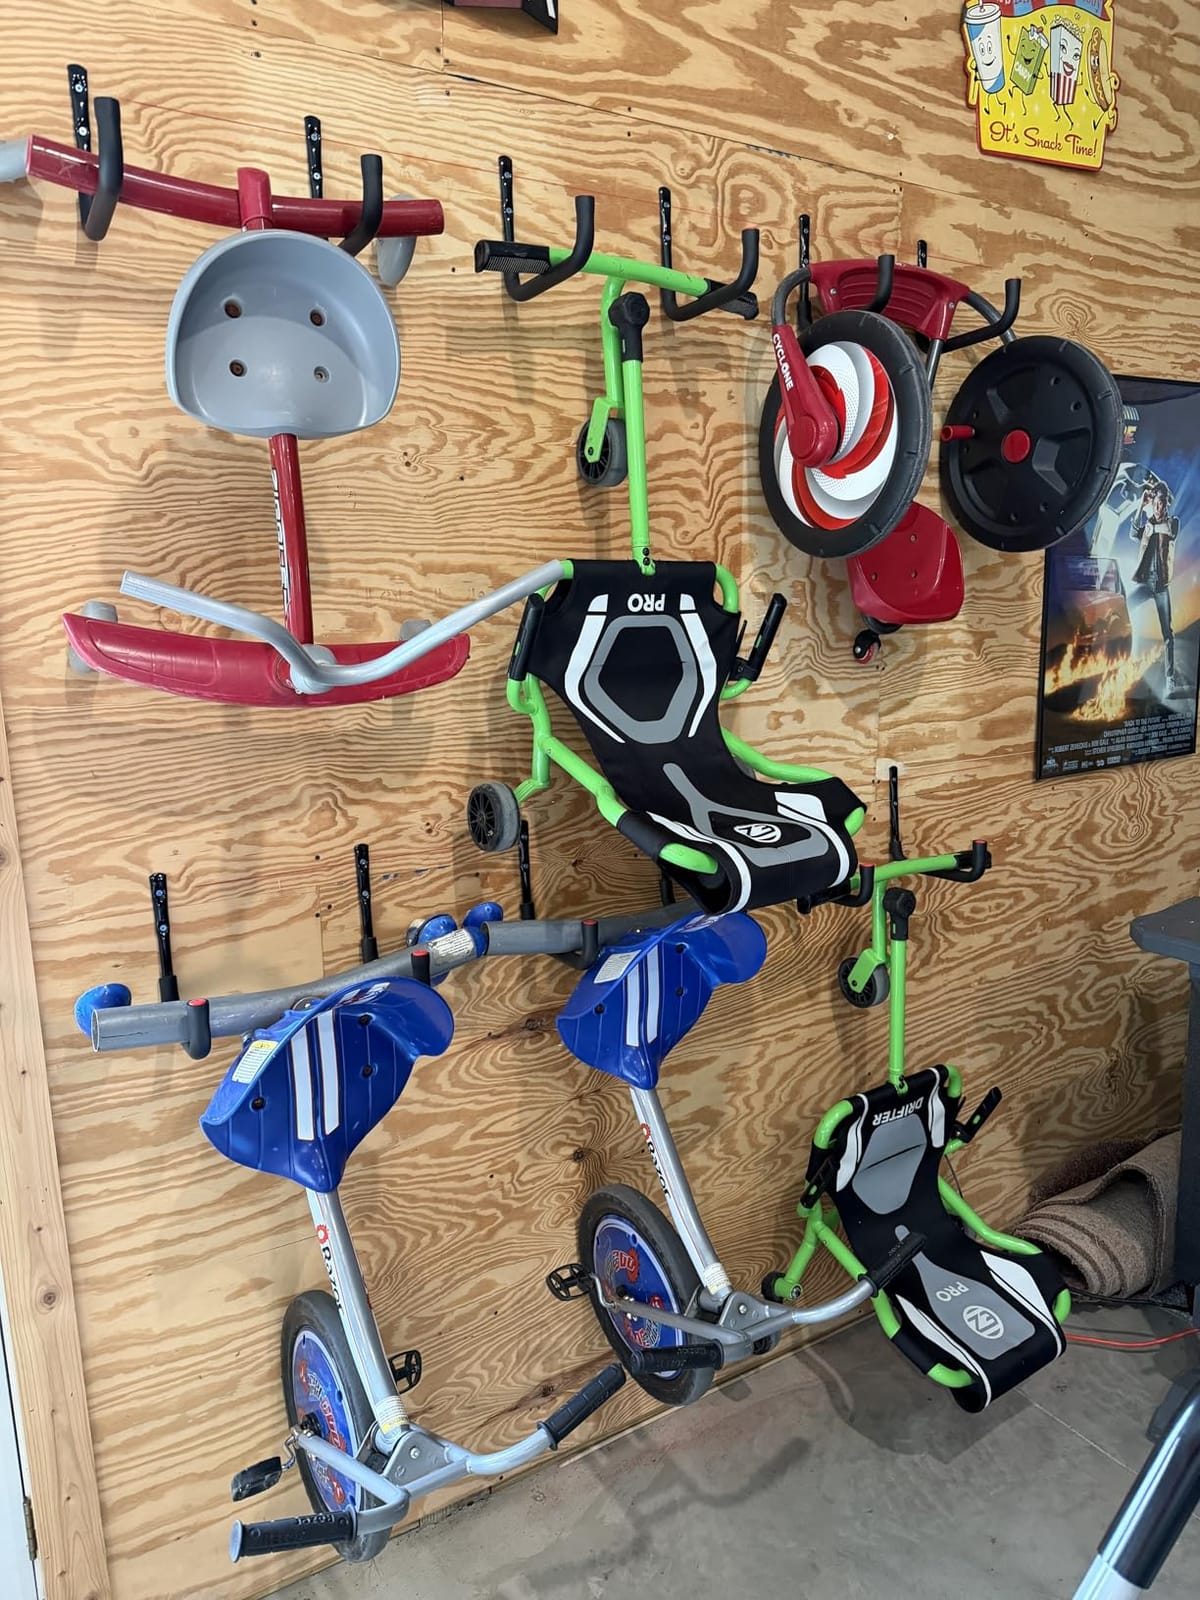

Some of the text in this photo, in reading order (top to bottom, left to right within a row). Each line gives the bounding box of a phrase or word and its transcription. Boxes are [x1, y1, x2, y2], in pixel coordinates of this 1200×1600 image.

[989, 120, 1098, 158] It's Snack Time!
[773, 333, 794, 391] CYCLONE
[627, 593, 666, 613] PRO
[872, 1096, 924, 1126] DRIFTER
[935, 1281, 969, 1302] PRO
